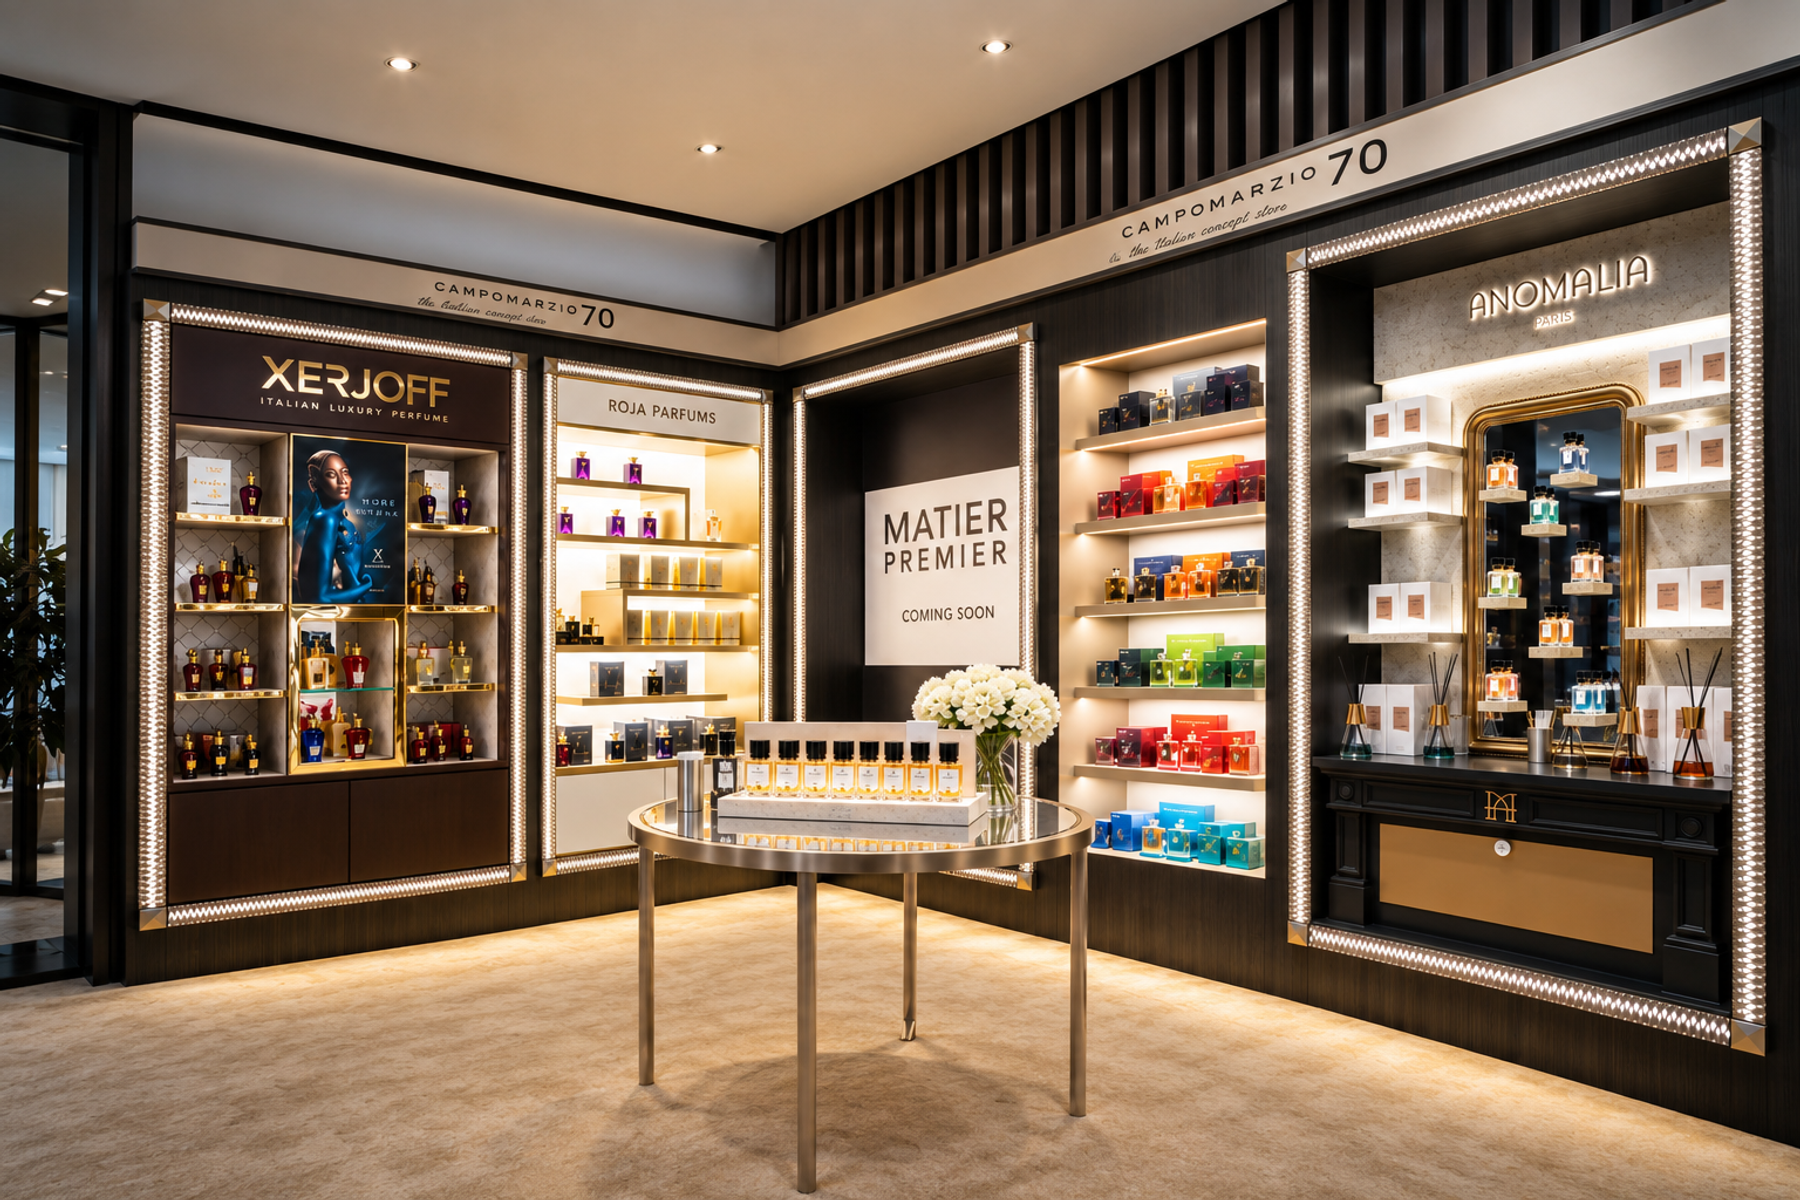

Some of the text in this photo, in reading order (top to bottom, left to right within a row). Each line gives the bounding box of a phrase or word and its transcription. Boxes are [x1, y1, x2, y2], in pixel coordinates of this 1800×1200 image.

[1121, 138, 1388, 239] CAMPOMARZIO 70
[434, 281, 615, 329] CAMPOMARZIO 70
[1469, 255, 1651, 320] ANOMALIA
[1534, 310, 1575, 330] PARIS
[261, 355, 450, 408] XERJOFF
[260, 396, 449, 424] ITALIAN LUXURY PERFUME
[608, 398, 717, 425] ROJA PARFUMS
[884, 498, 1008, 545] MATIER
[884, 539, 1008, 575] PREMIER
[901, 604, 996, 623] COMING SOON
